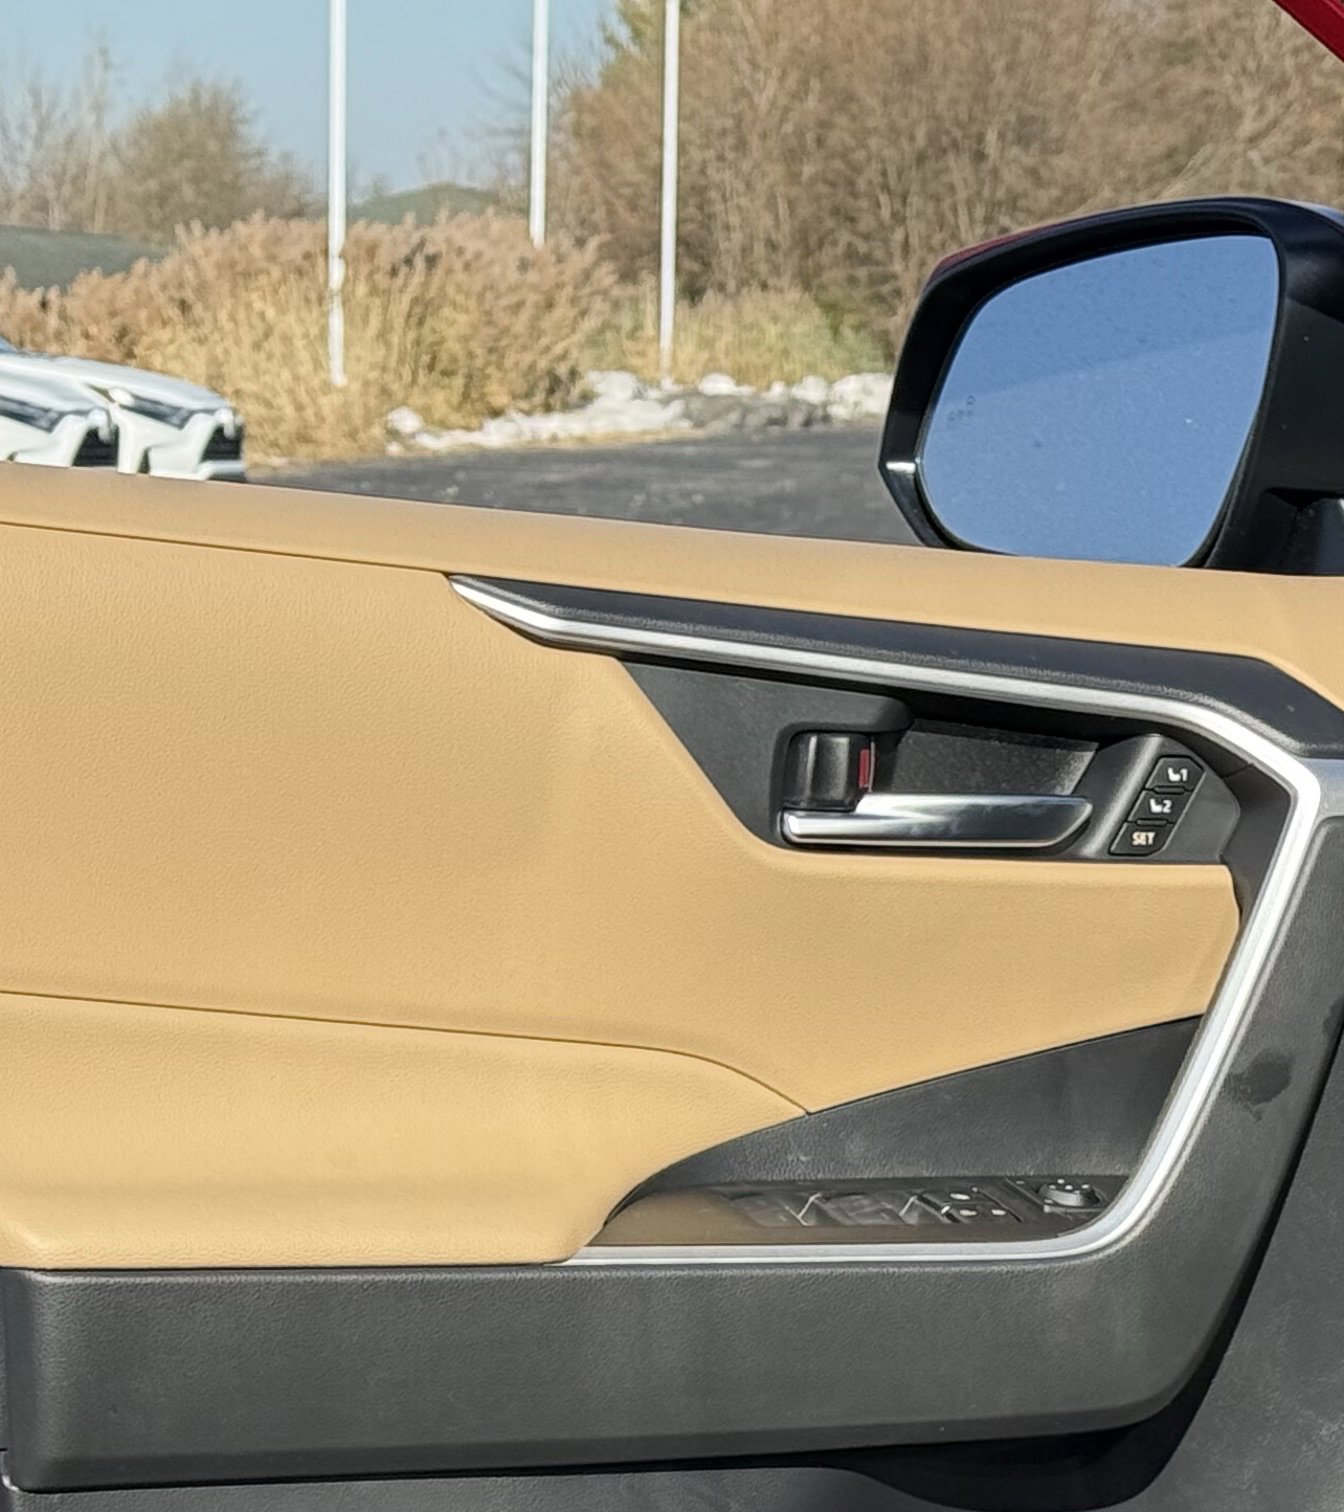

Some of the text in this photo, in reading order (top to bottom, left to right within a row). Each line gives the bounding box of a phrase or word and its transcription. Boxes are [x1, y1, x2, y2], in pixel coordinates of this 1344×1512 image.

[1180, 768, 1188, 782] 1
[1162, 799, 1172, 813] 2
[1131, 831, 1156, 846] SET
